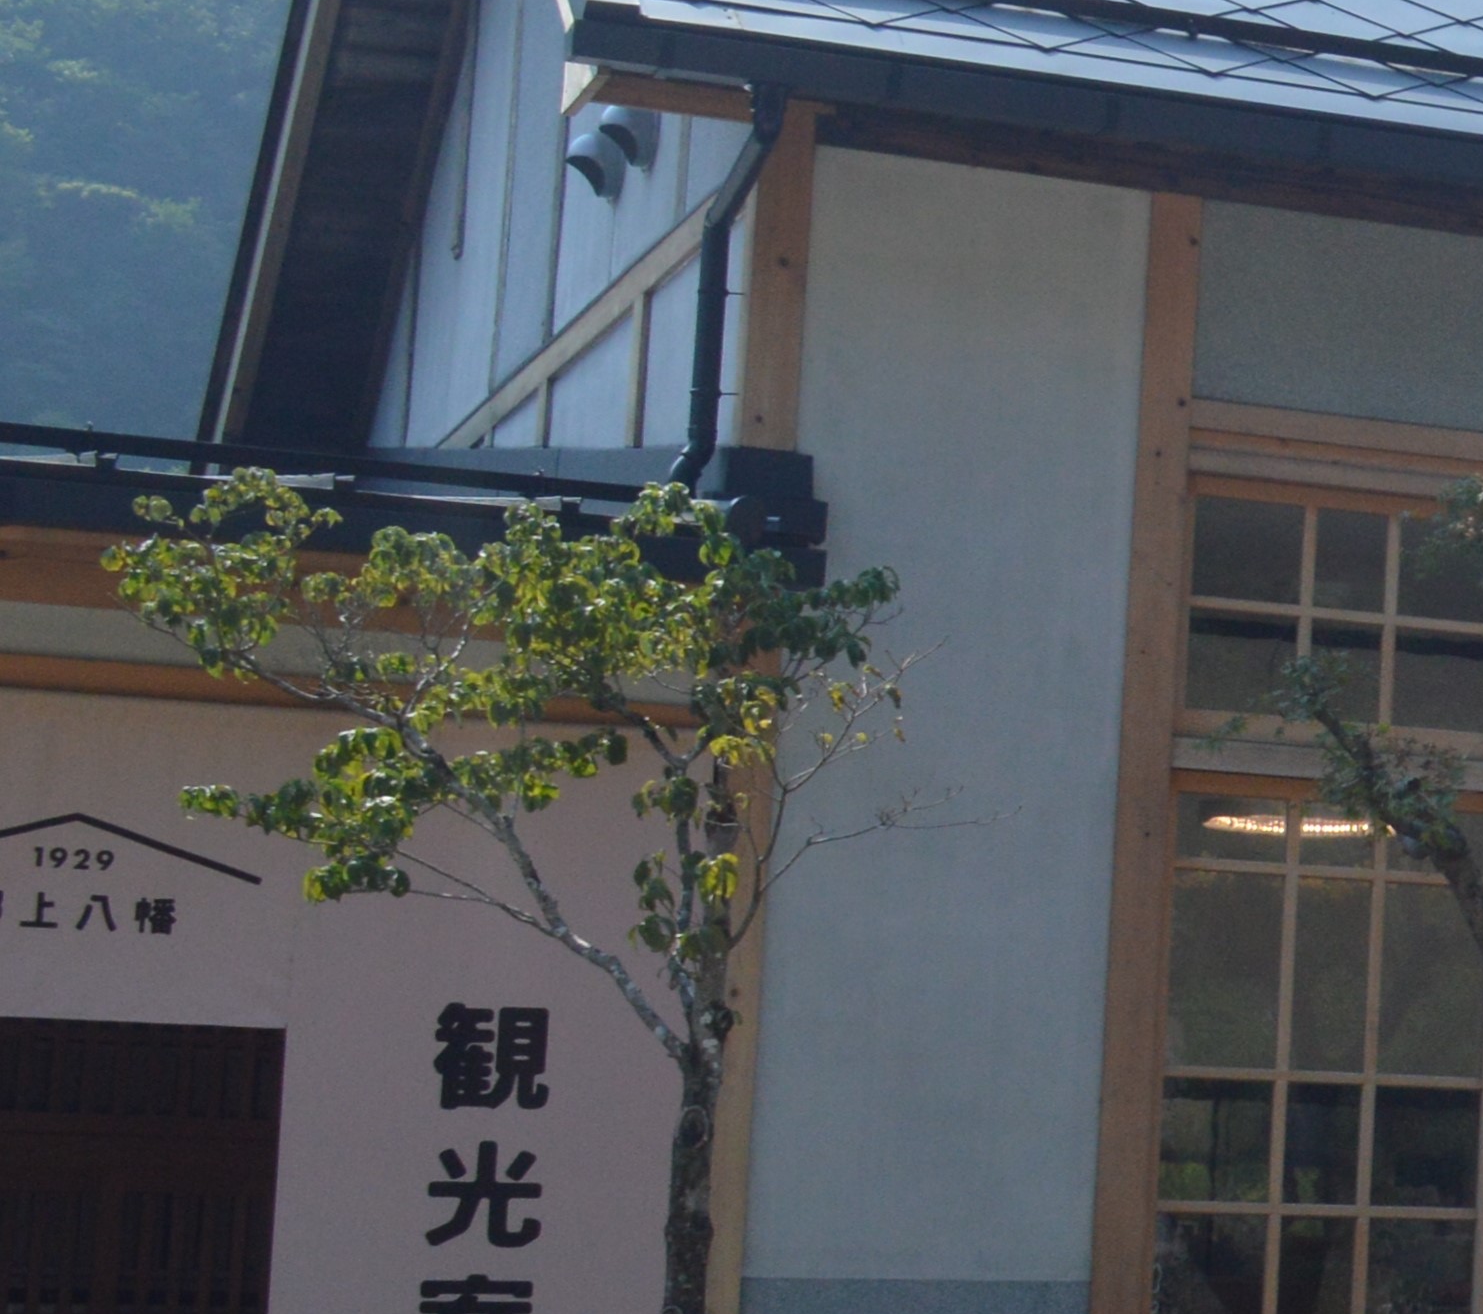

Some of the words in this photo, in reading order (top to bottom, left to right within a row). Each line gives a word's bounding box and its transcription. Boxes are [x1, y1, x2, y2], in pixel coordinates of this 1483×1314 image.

[33, 846, 115, 871] 1929
[0, 890, 178, 935] 上八幡
